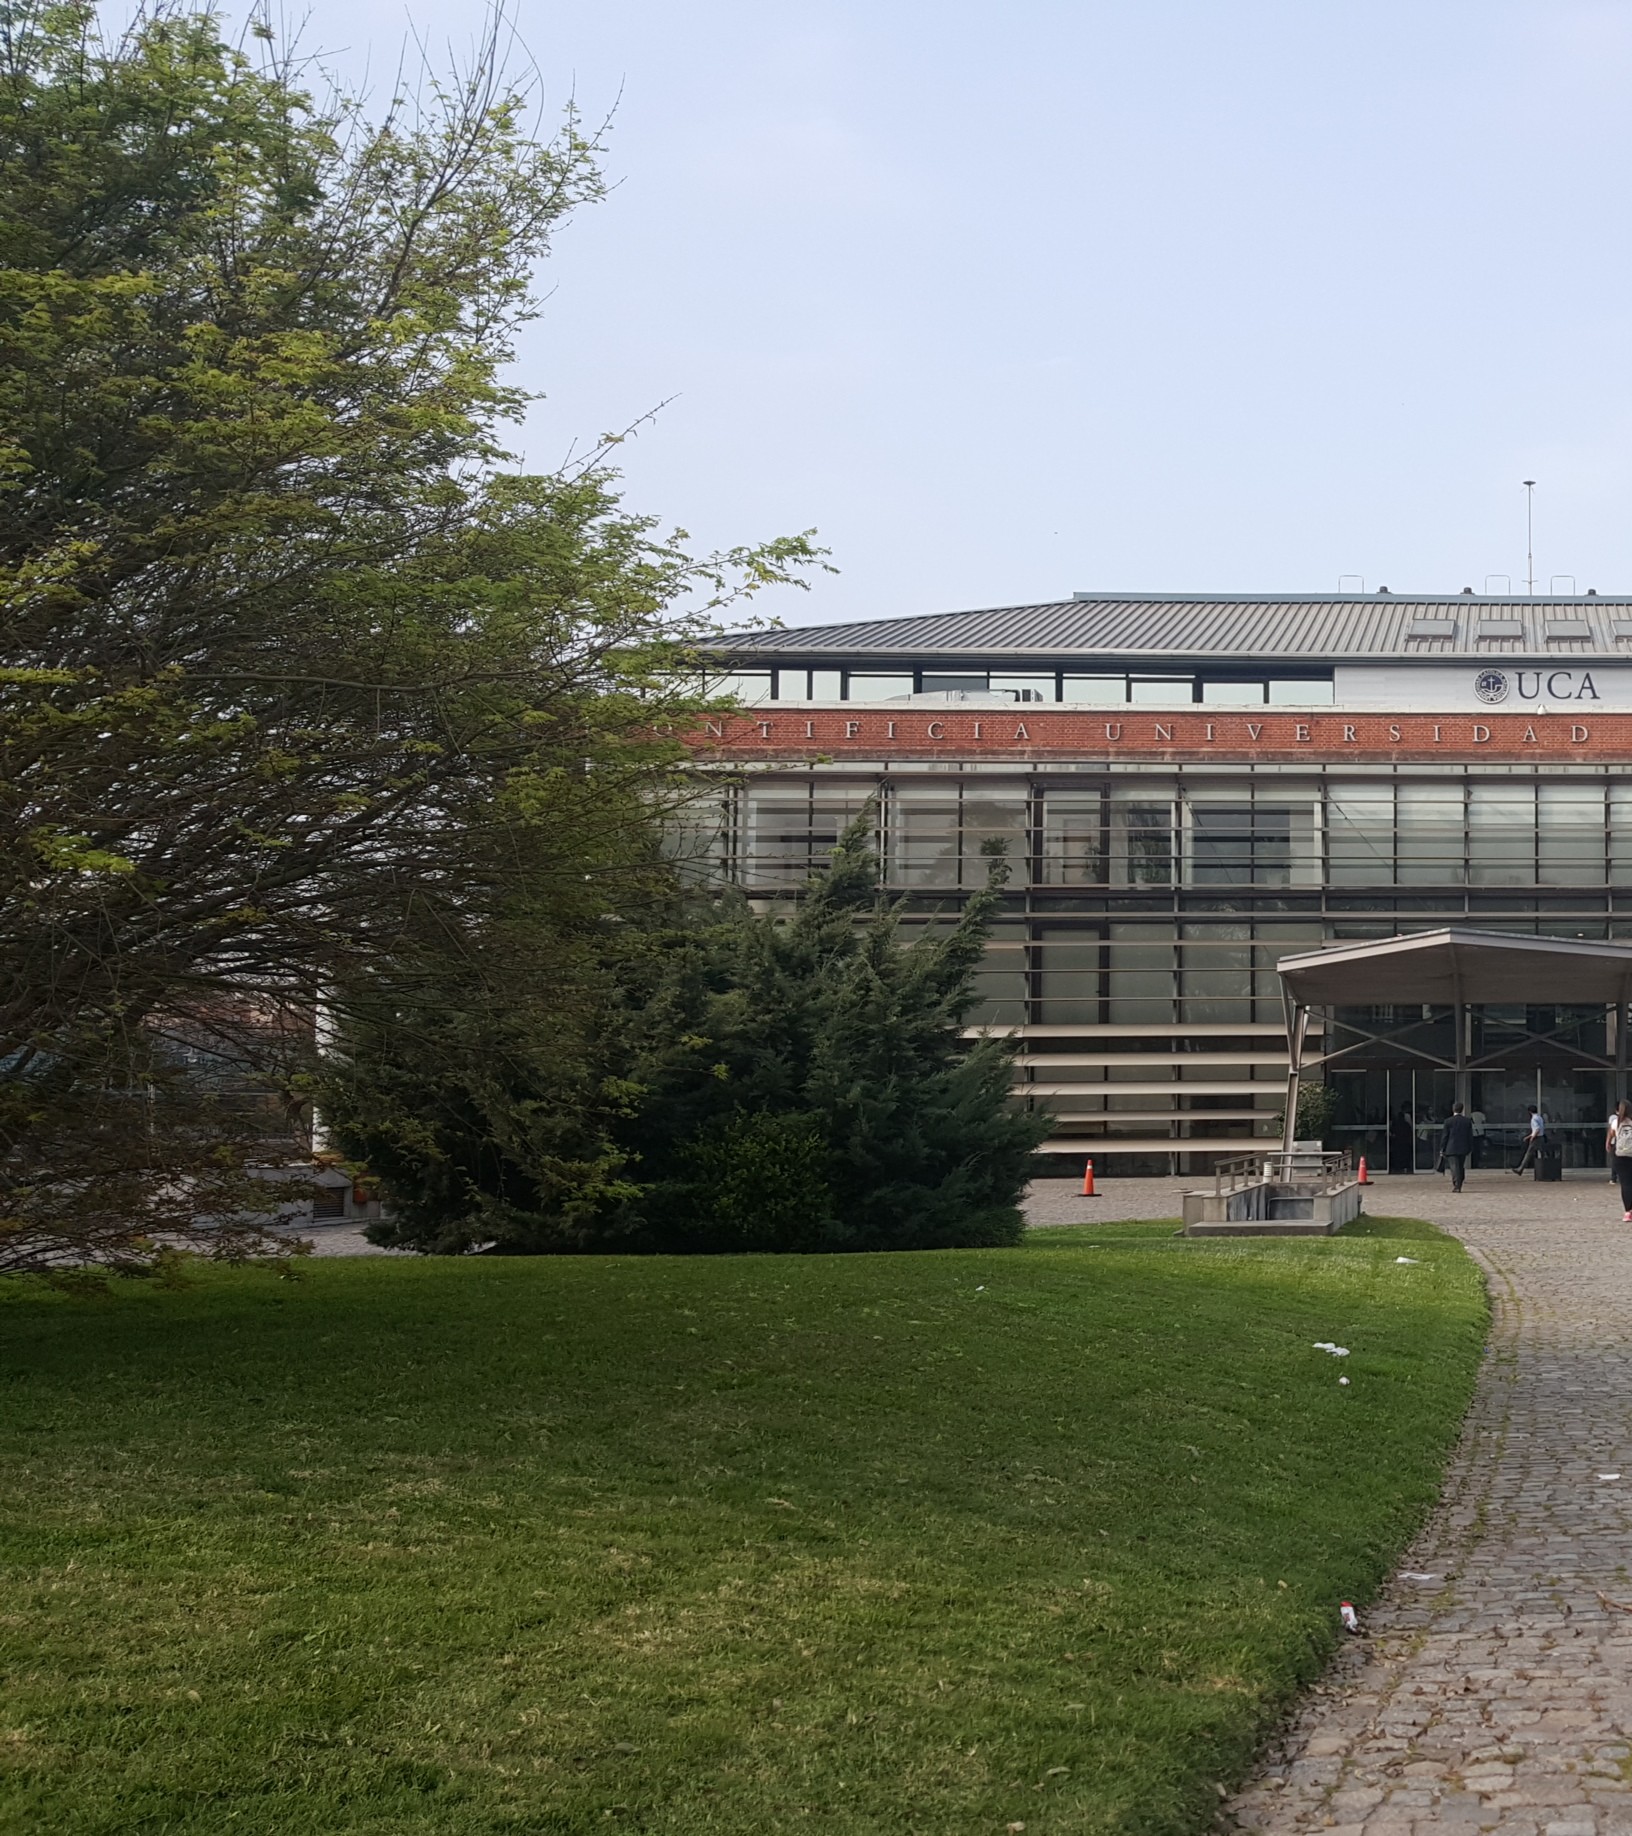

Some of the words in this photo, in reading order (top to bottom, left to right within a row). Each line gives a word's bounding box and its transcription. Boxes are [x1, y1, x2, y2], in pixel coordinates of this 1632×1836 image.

[1515, 671, 1601, 700] UCA
[652, 720, 1031, 740] ONTIFICIA
[1105, 722, 1589, 743] UNIVERSIDAD
